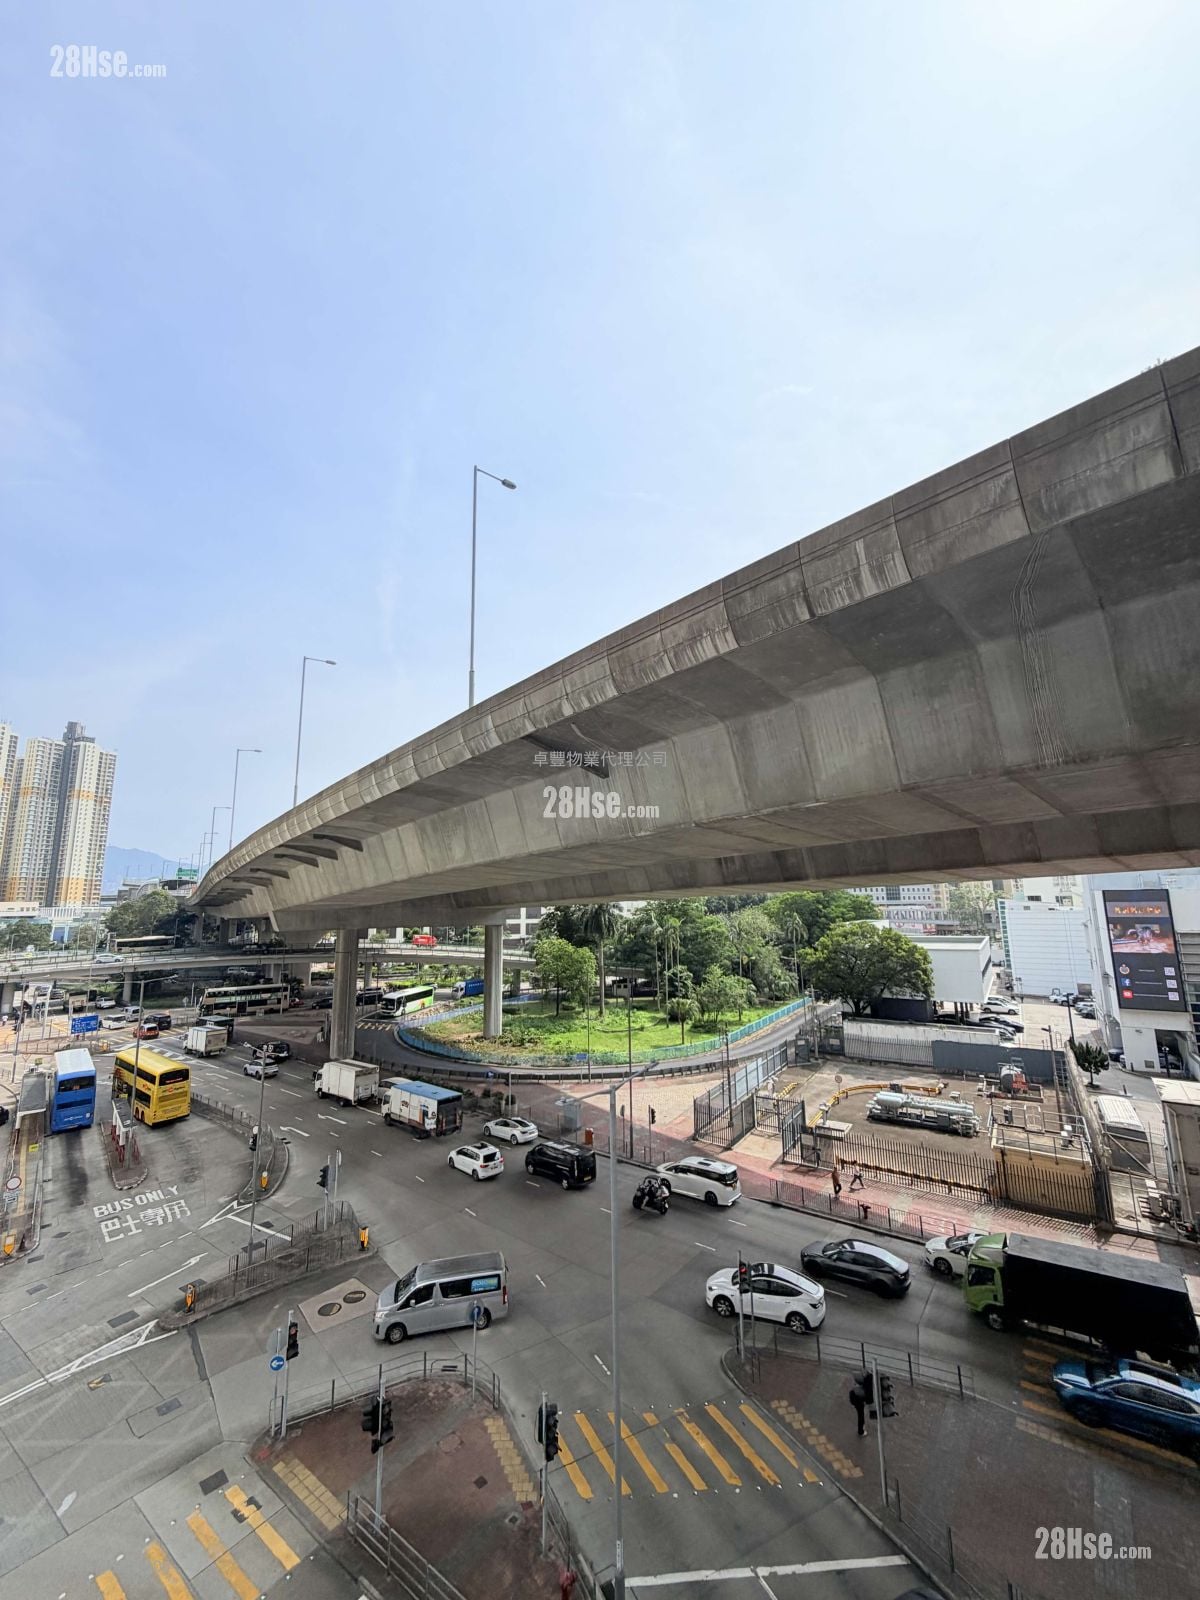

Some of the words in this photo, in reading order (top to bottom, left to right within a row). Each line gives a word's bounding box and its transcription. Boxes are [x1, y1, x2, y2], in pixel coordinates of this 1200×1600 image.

[93, 1198, 134, 1218] BUS
[100, 1199, 191, 1243] 巴士專用
